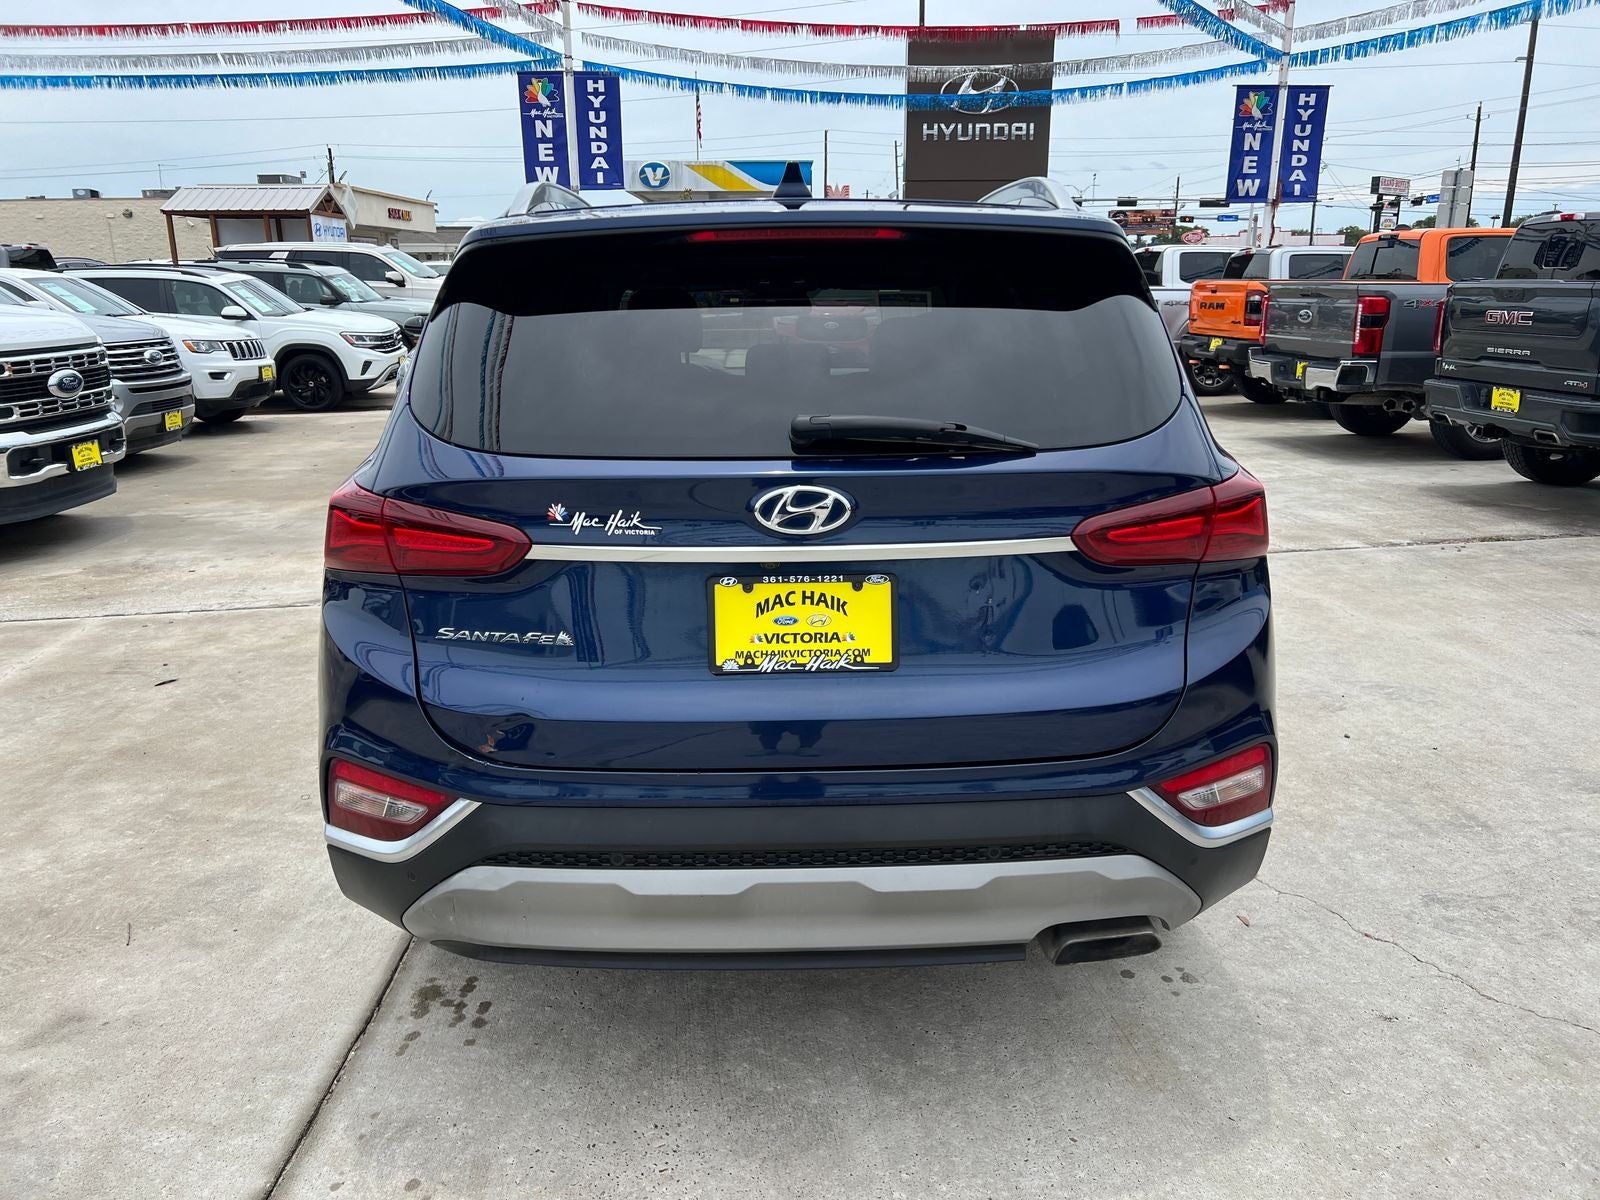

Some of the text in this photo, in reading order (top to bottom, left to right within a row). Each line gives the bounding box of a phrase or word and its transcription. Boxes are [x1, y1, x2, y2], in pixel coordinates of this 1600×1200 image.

[586, 79, 609, 184] HYUNDAI
[922, 122, 1035, 142] HYUNDAI
[534, 119, 559, 184] NEW
[1288, 93, 1317, 196] HYUNDAI
[1236, 132, 1261, 197] NEW
[1199, 301, 1226, 310] RAM
[1485, 309, 1534, 326] GMC
[1486, 347, 1531, 356] SIERRA
[569, 509, 647, 536] Mac Haik
[762, 575, 844, 583] 361-576-1221
[869, 575, 887, 584] Ford
[755, 590, 849, 619] MAC HAIK
[776, 617, 795, 626] Ford
[763, 631, 842, 645] VICTORIA
[734, 648, 872, 660] MACHAIKVICTORIACOM
[757, 652, 853, 673] Mac Haik
